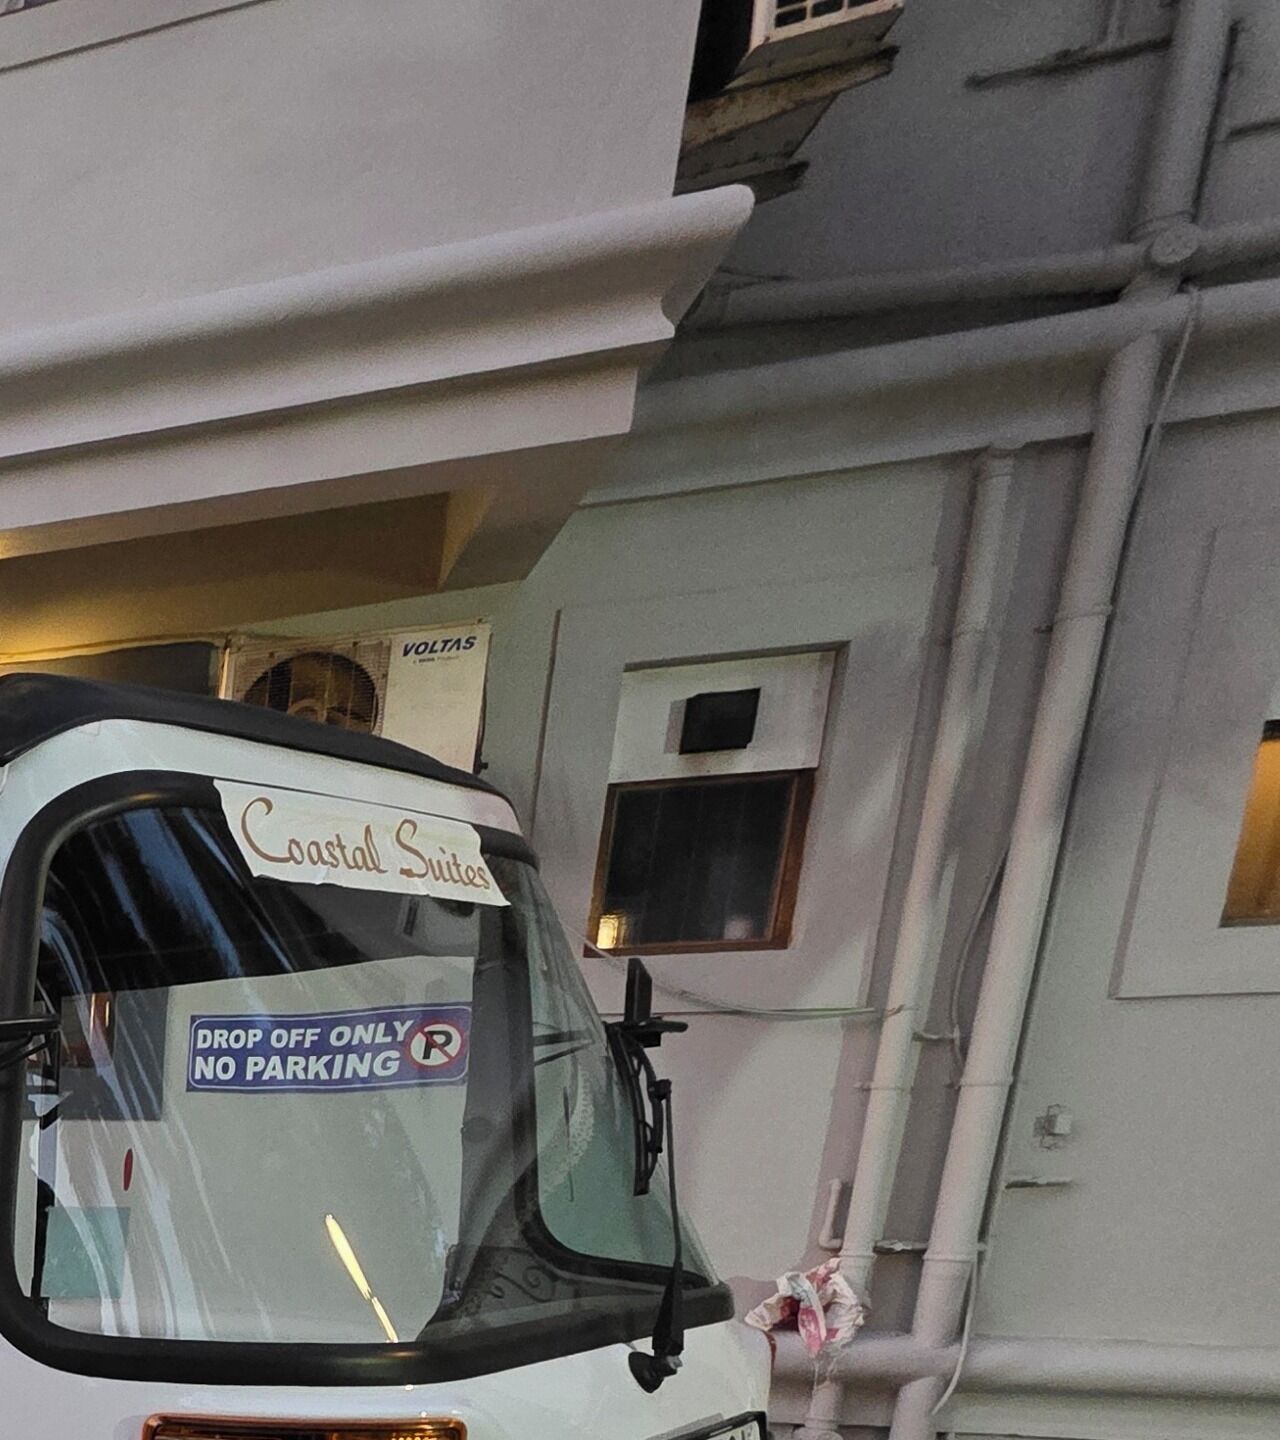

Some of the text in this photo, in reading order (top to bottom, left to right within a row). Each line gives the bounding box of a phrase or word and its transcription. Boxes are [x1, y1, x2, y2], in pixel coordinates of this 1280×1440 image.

[401, 635, 478, 658] VOLTAS
[241, 796, 491, 890] Coastal Suites
[196, 1019, 414, 1049] DROP OFF ONLY
[194, 1050, 401, 1081] NO PARKING
